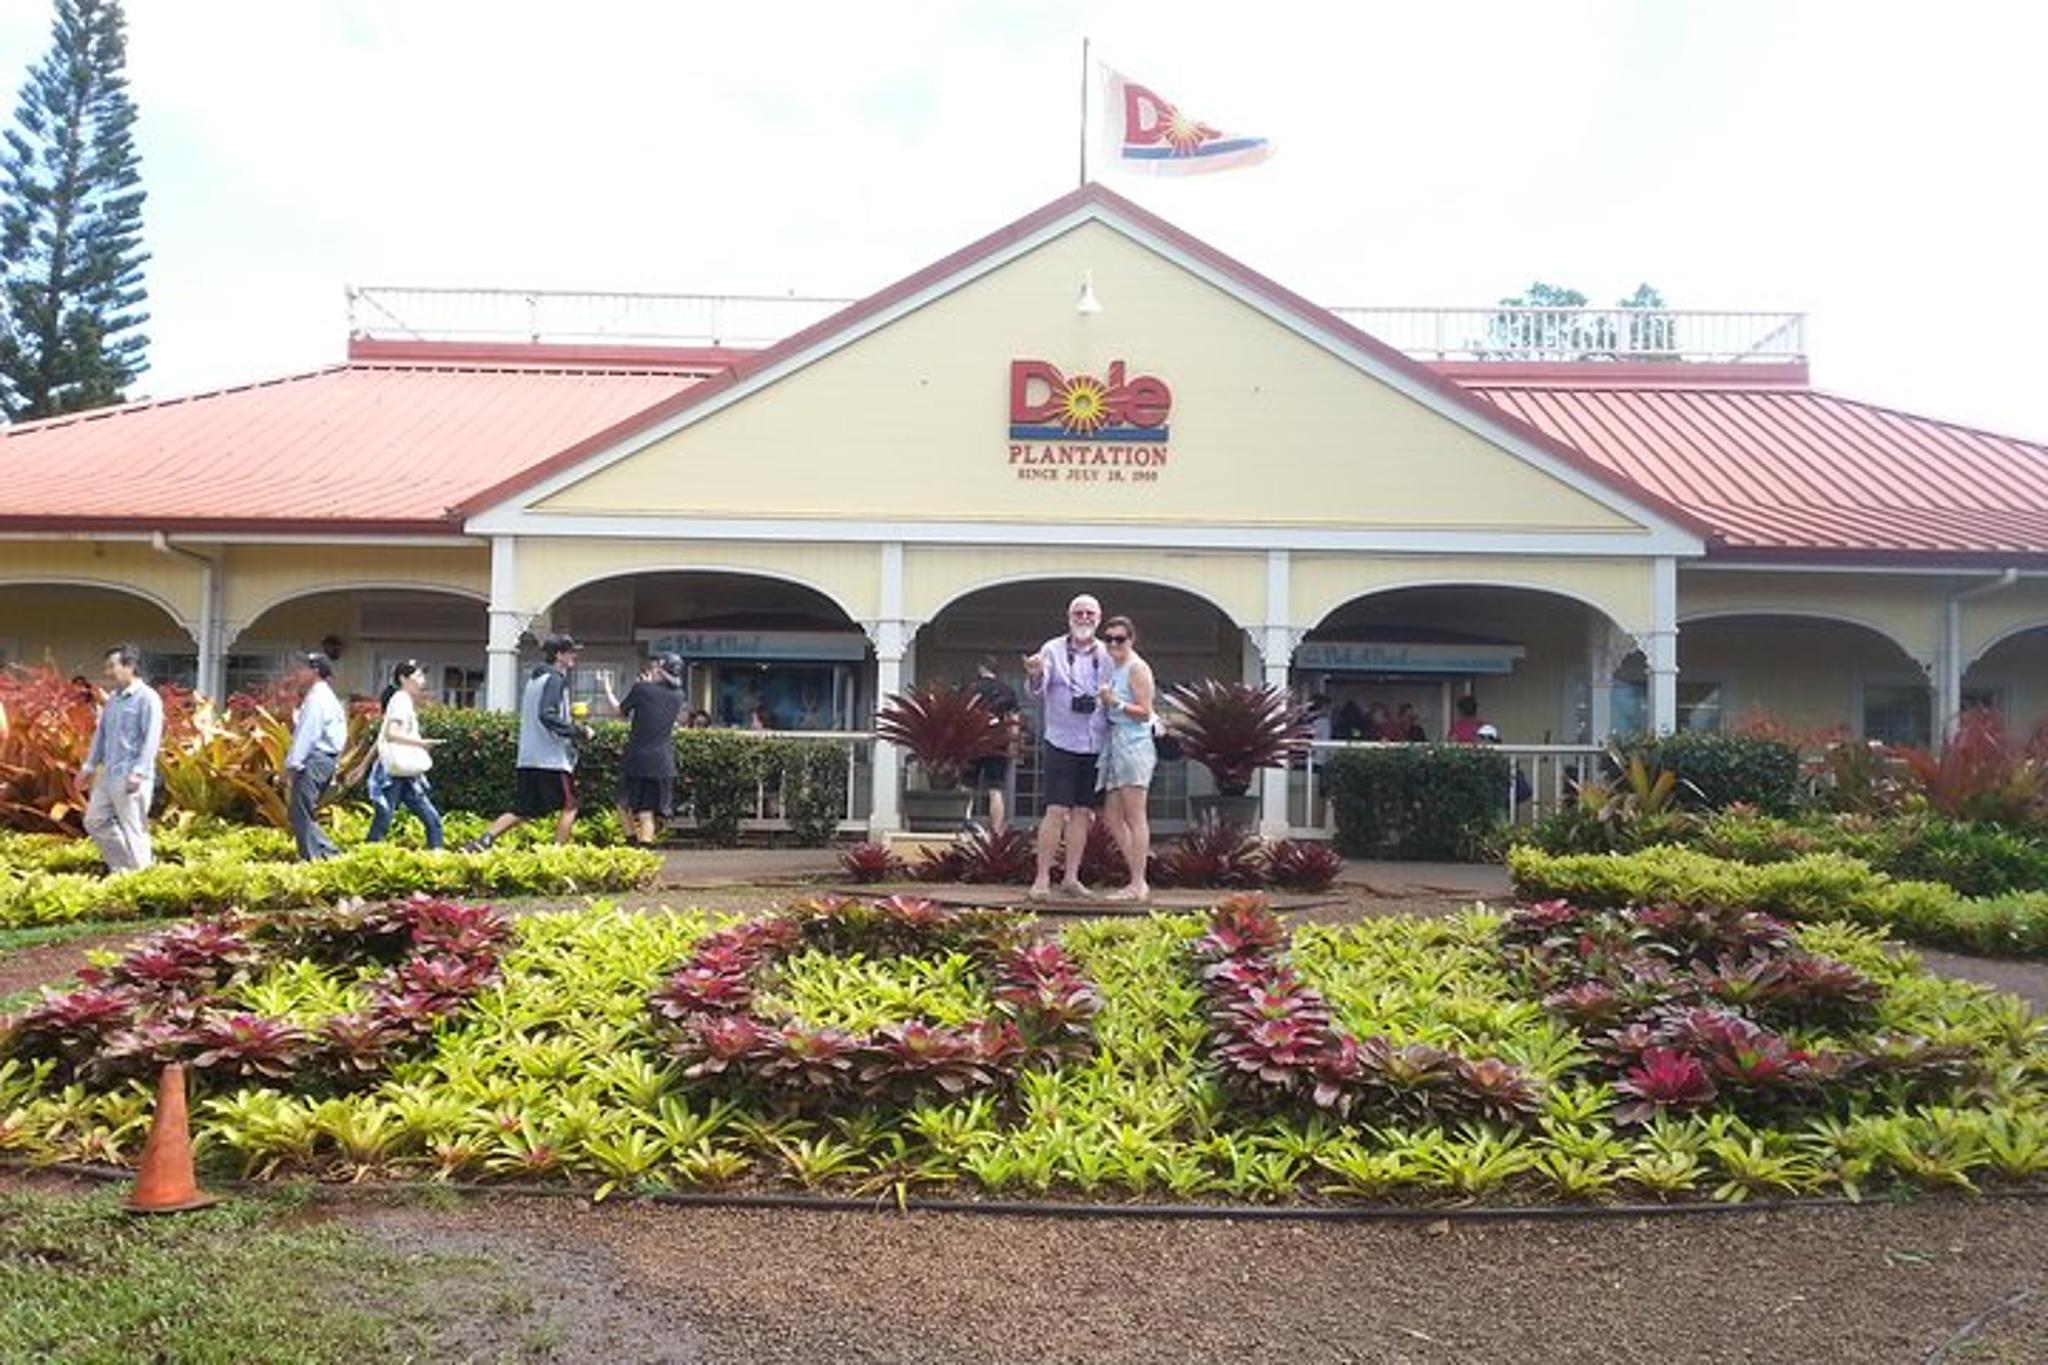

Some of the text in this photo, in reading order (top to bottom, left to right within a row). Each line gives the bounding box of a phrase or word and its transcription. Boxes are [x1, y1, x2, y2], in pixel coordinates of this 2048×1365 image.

[1010, 360, 1172, 428] Dole
[1008, 444, 1167, 466] PLANTATION
[1018, 468, 1058, 480] SINCE
